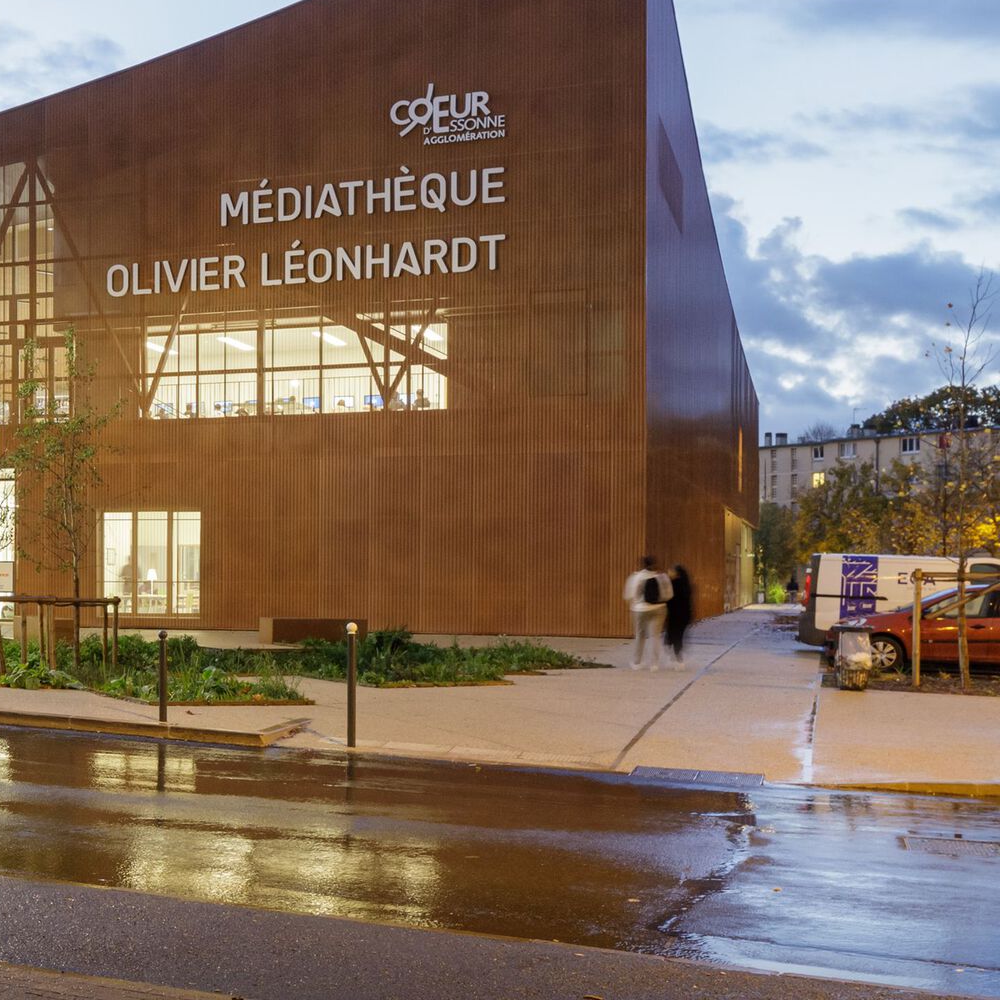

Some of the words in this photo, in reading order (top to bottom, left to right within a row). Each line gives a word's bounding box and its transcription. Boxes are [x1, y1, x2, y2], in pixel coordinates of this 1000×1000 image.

[423, 129, 505, 146] AGGLOMÉRATION
[220, 166, 506, 227] MÉDIATHÈQUE
[106, 255, 246, 298] OLIVIER
[260, 234, 506, 287] LÉONHARDT
